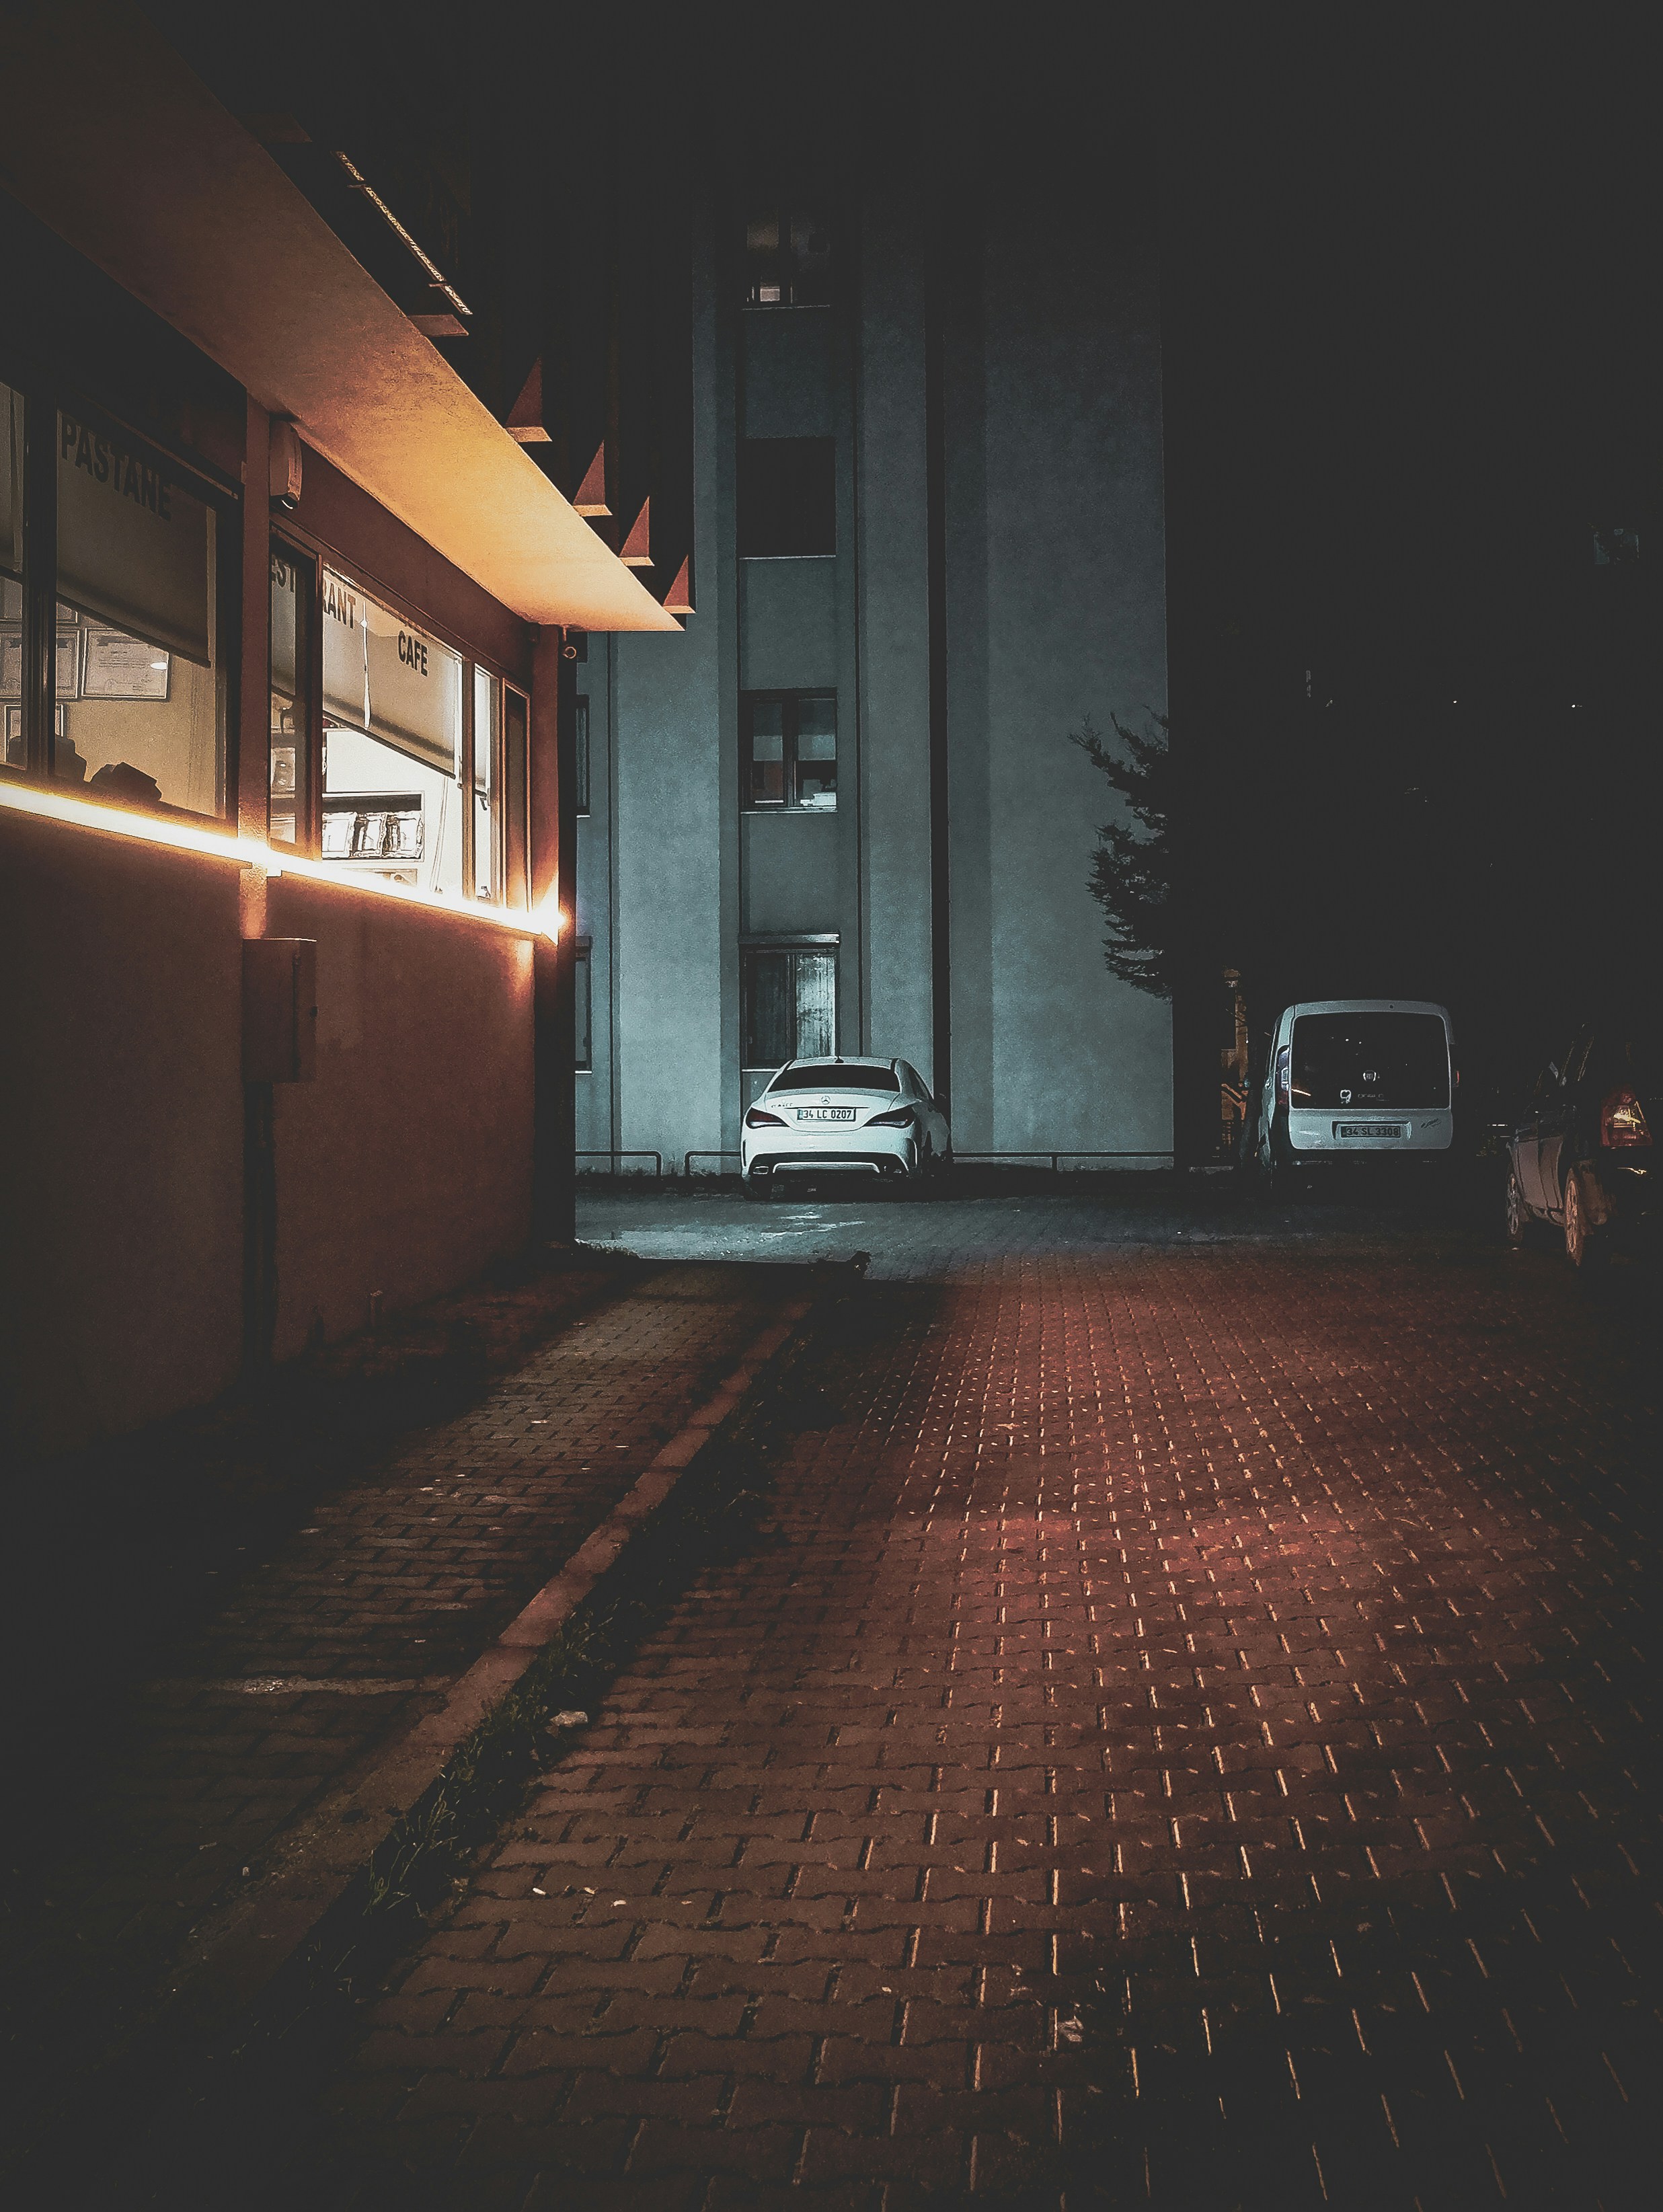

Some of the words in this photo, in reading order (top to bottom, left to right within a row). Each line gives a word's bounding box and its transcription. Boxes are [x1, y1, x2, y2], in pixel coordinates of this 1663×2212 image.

[61, 414, 171, 522] PASTANE
[397, 630, 428, 677] CAFE
[803, 1110, 813, 1118] 34
[817, 1110, 827, 1118] LC
[830, 1110, 852, 1119] 0207
[1346, 1127, 1358, 1136] 34
[1362, 1127, 1373, 1136] SL
[1375, 1127, 1399, 1137] 3308
